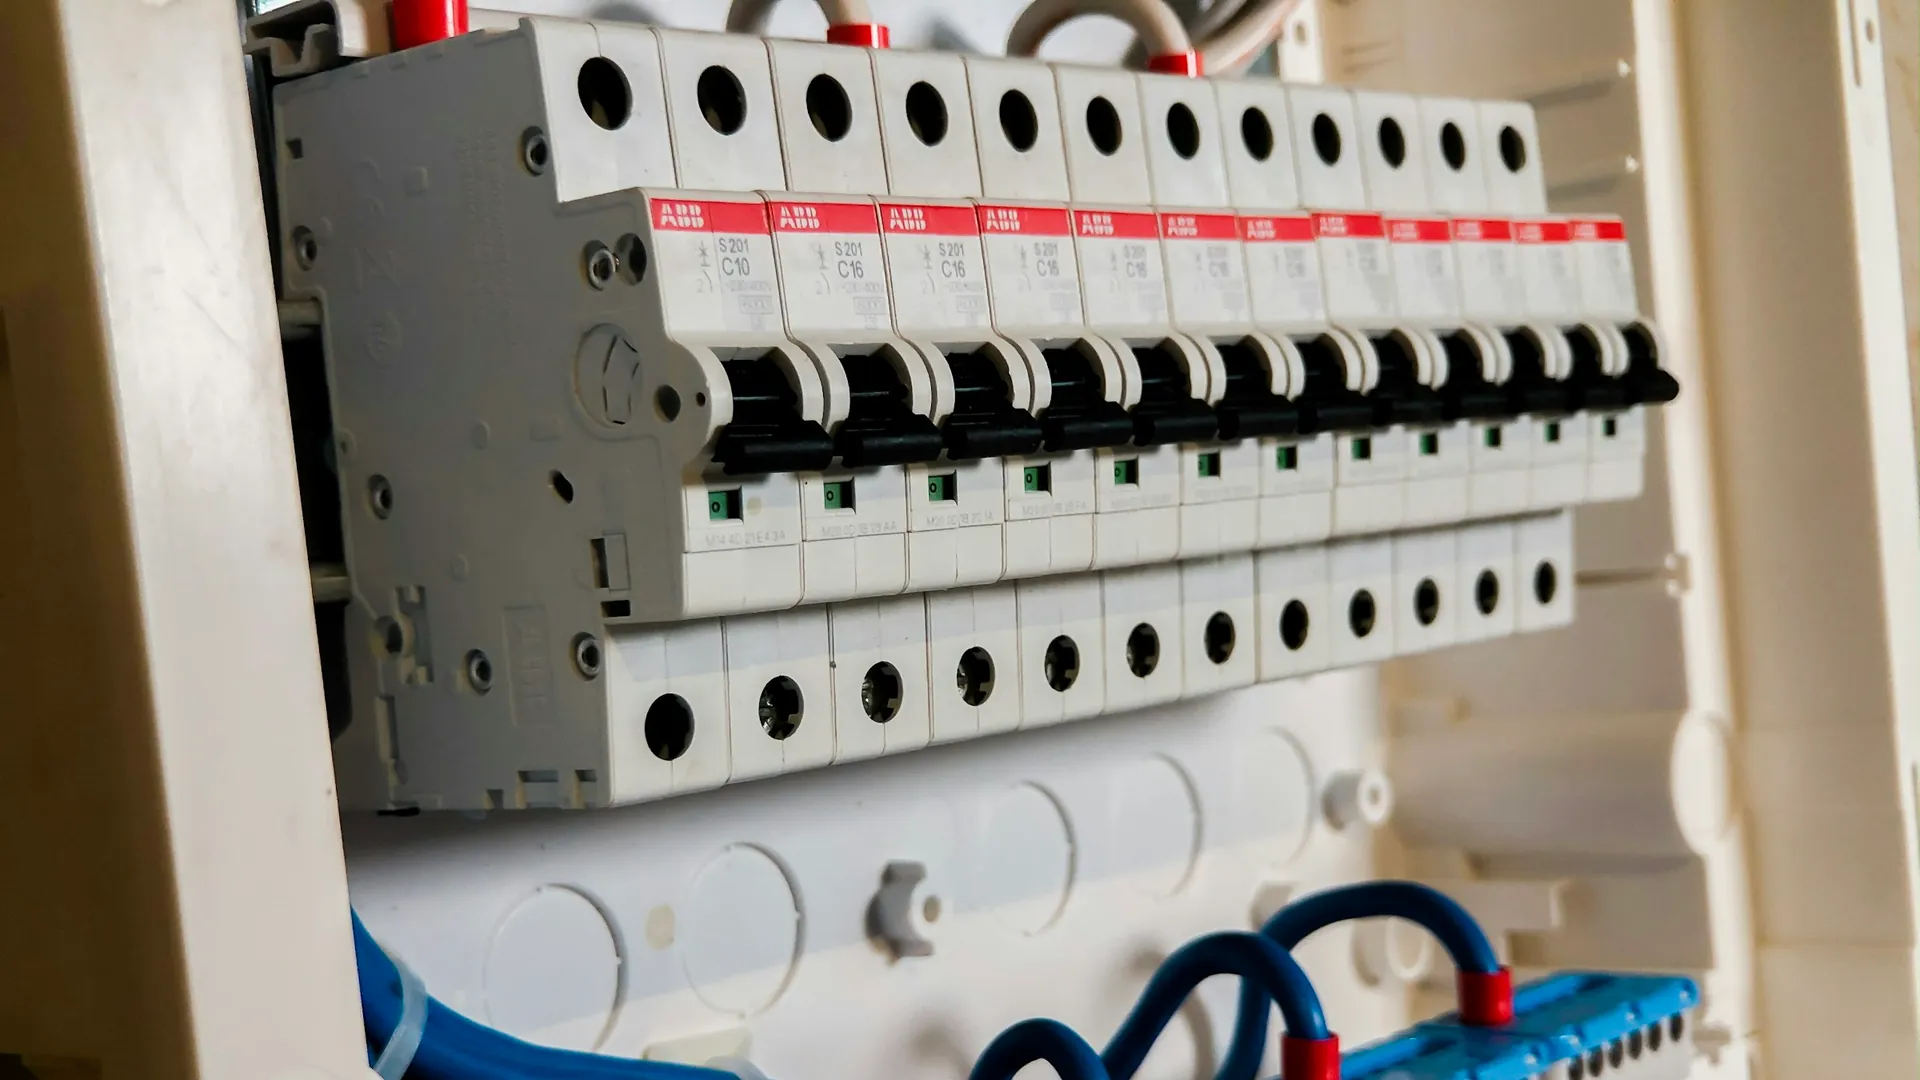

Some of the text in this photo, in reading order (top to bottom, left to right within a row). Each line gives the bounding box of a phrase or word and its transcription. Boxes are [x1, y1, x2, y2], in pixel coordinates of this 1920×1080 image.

[661, 203, 704, 228] ABB
[780, 206, 820, 229] ABB
[890, 208, 926, 230] ABB
[986, 209, 1021, 231] ABB
[1082, 214, 1114, 235] ABB
[1167, 216, 1198, 236] ABB
[722, 257, 750, 276] C10
[838, 260, 864, 279] C16
[942, 260, 965, 279] C16
